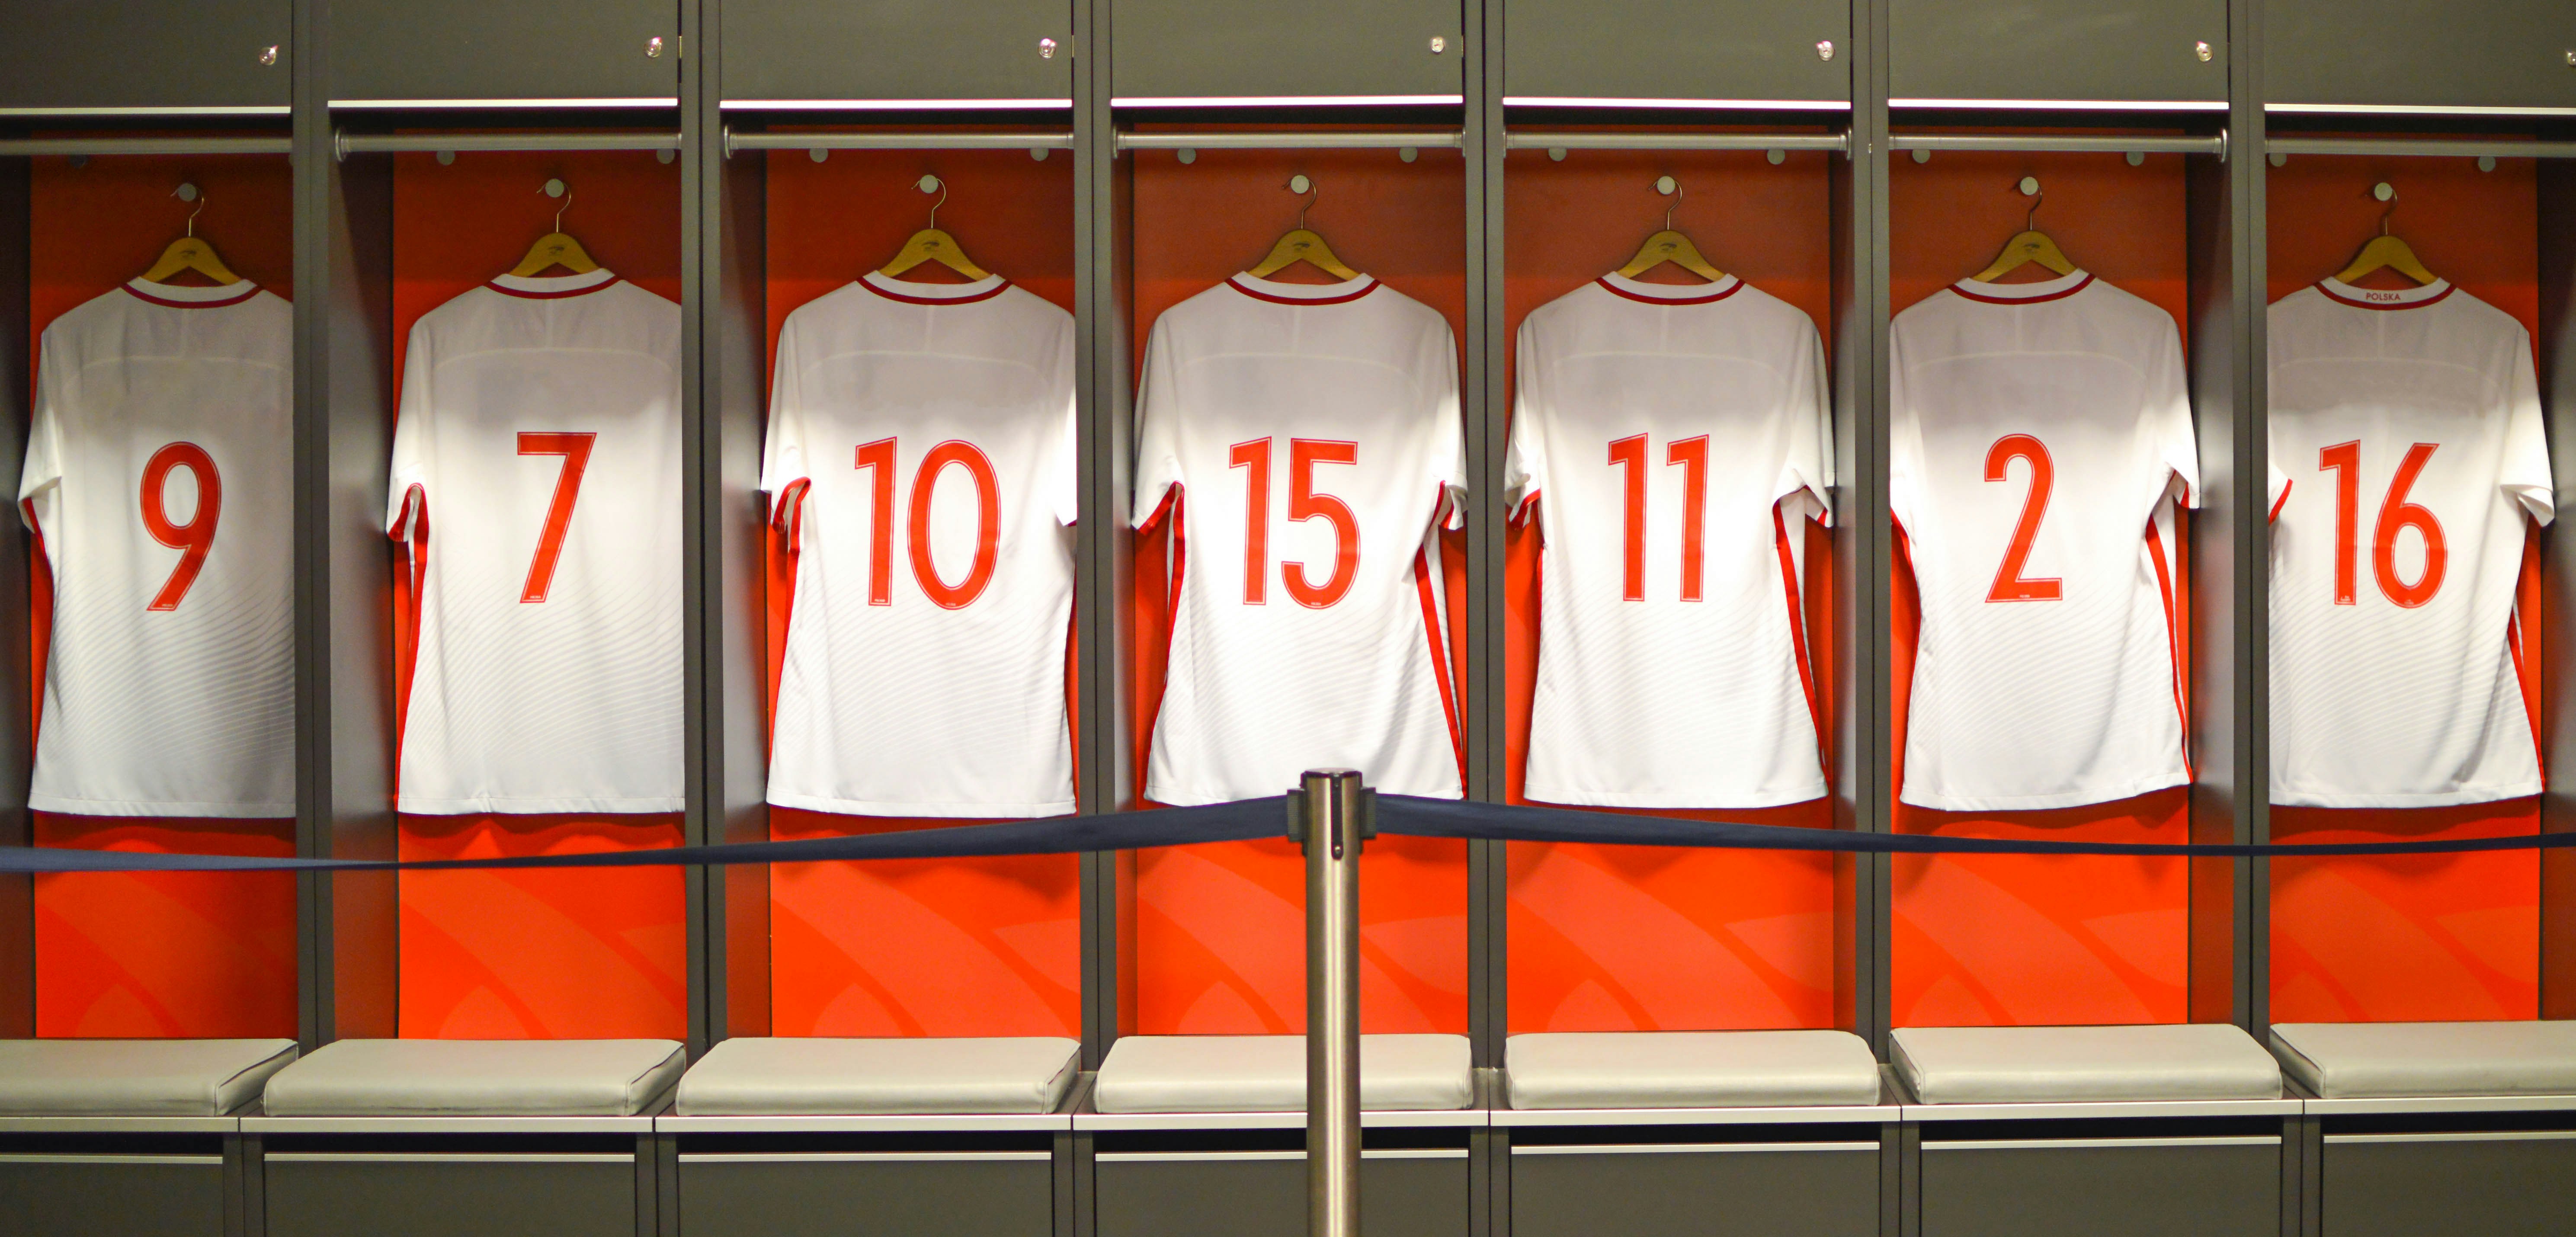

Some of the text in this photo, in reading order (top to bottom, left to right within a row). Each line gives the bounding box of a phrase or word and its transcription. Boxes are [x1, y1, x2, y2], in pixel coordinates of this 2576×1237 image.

[2366, 292, 2401, 301] POLSKA
[140, 441, 222, 612] 9
[517, 432, 597, 604] 7
[855, 436, 1001, 611] 10
[1229, 436, 1361, 610] 15
[1608, 433, 1709, 602] 11
[1984, 433, 2063, 603] 2
[2319, 439, 2448, 609] 16
